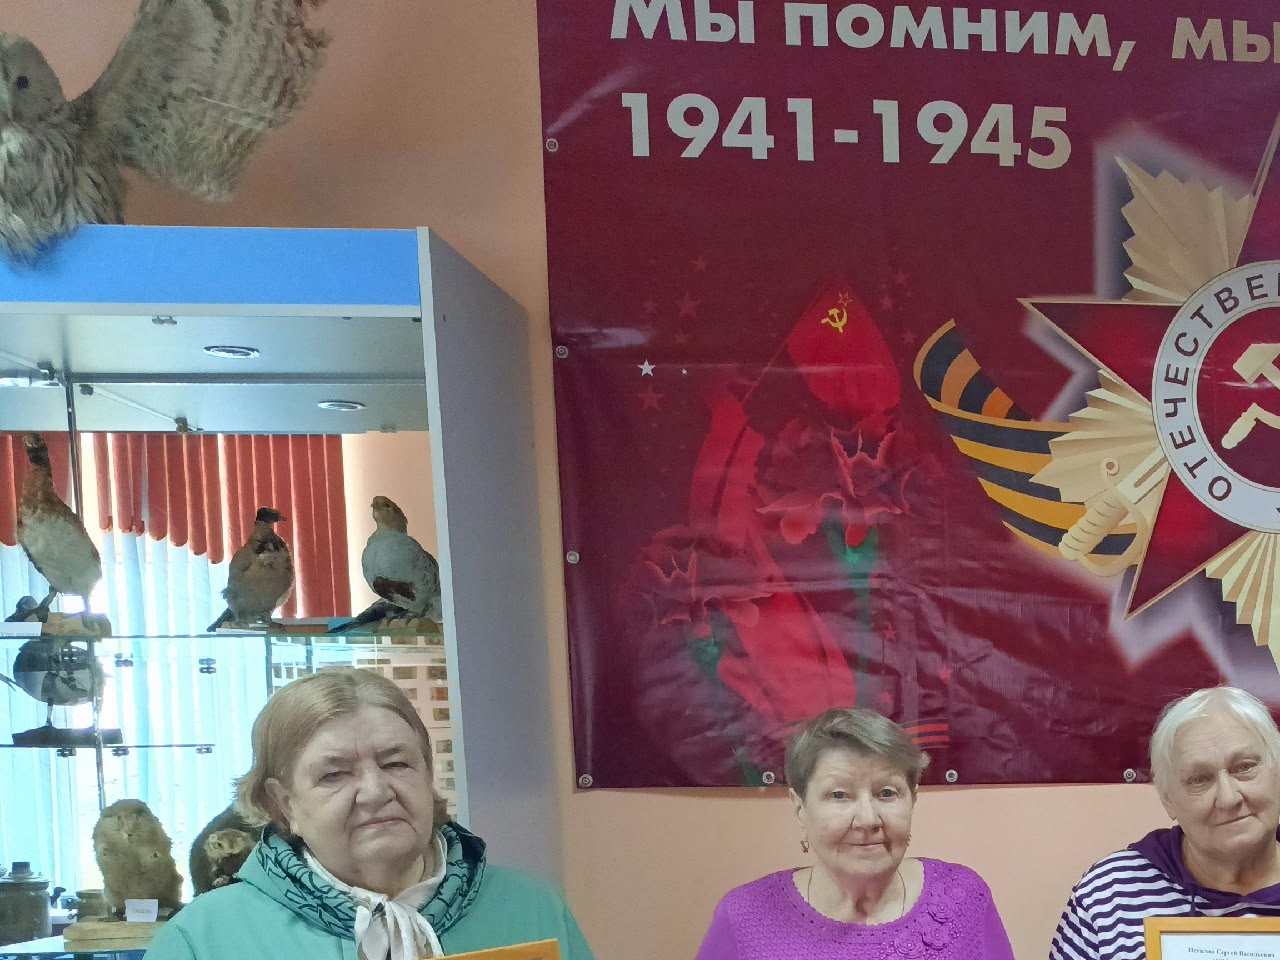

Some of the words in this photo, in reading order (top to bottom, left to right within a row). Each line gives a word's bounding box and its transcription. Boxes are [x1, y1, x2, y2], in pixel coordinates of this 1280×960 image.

[610, 0, 755, 43] Мы
[784, 3, 1136, 71] помним,
[621, 92, 1072, 170] 1941-1945
[1216, 948, 1237, 957] Сергей
[1239, 950, 1274, 959] Васильевич
